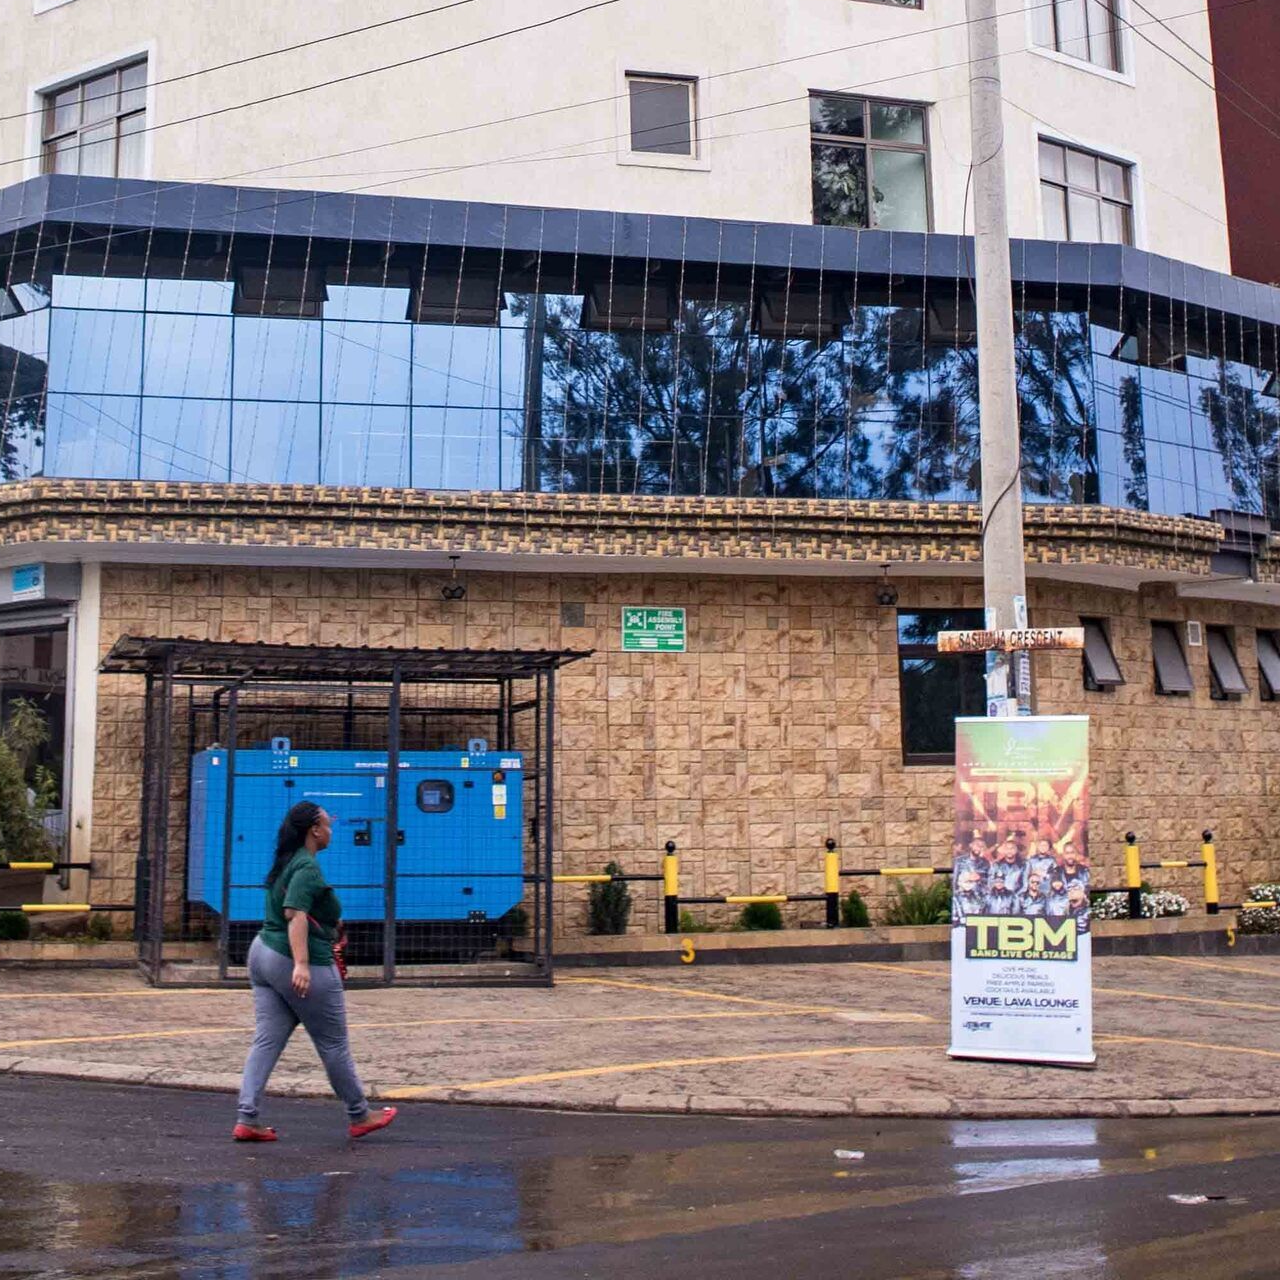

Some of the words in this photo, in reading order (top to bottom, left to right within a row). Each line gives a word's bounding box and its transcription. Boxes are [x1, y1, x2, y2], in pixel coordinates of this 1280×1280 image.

[1010, 631, 1063, 648] CRESCENT
[966, 917, 1076, 952] TBM
[680, 937, 696, 963] 3
[970, 949, 998, 958] BAND
[1001, 950, 1022, 958] LIVE
[1025, 951, 1039, 959] ON
[1041, 951, 1074, 960] STAGE
[963, 996, 1002, 1007] VENUE:
[1004, 997, 1032, 1007] LAVA
[1035, 998, 1079, 1009] LOUNGE
